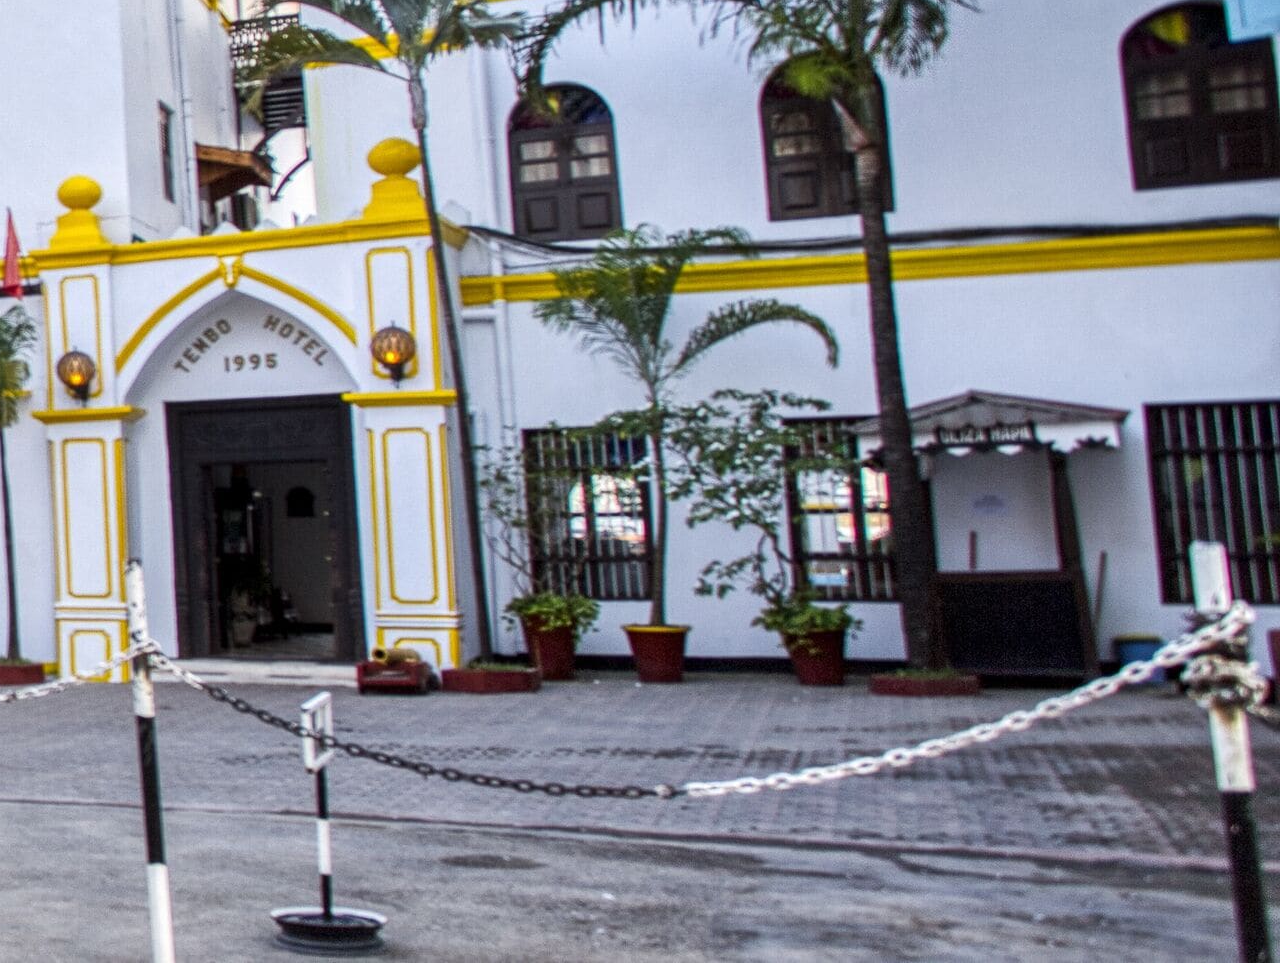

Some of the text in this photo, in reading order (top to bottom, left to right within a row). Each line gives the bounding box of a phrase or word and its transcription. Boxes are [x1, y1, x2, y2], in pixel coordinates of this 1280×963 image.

[173, 314, 330, 374] TEMBO HOTEL
[224, 352, 278, 373] 1995
